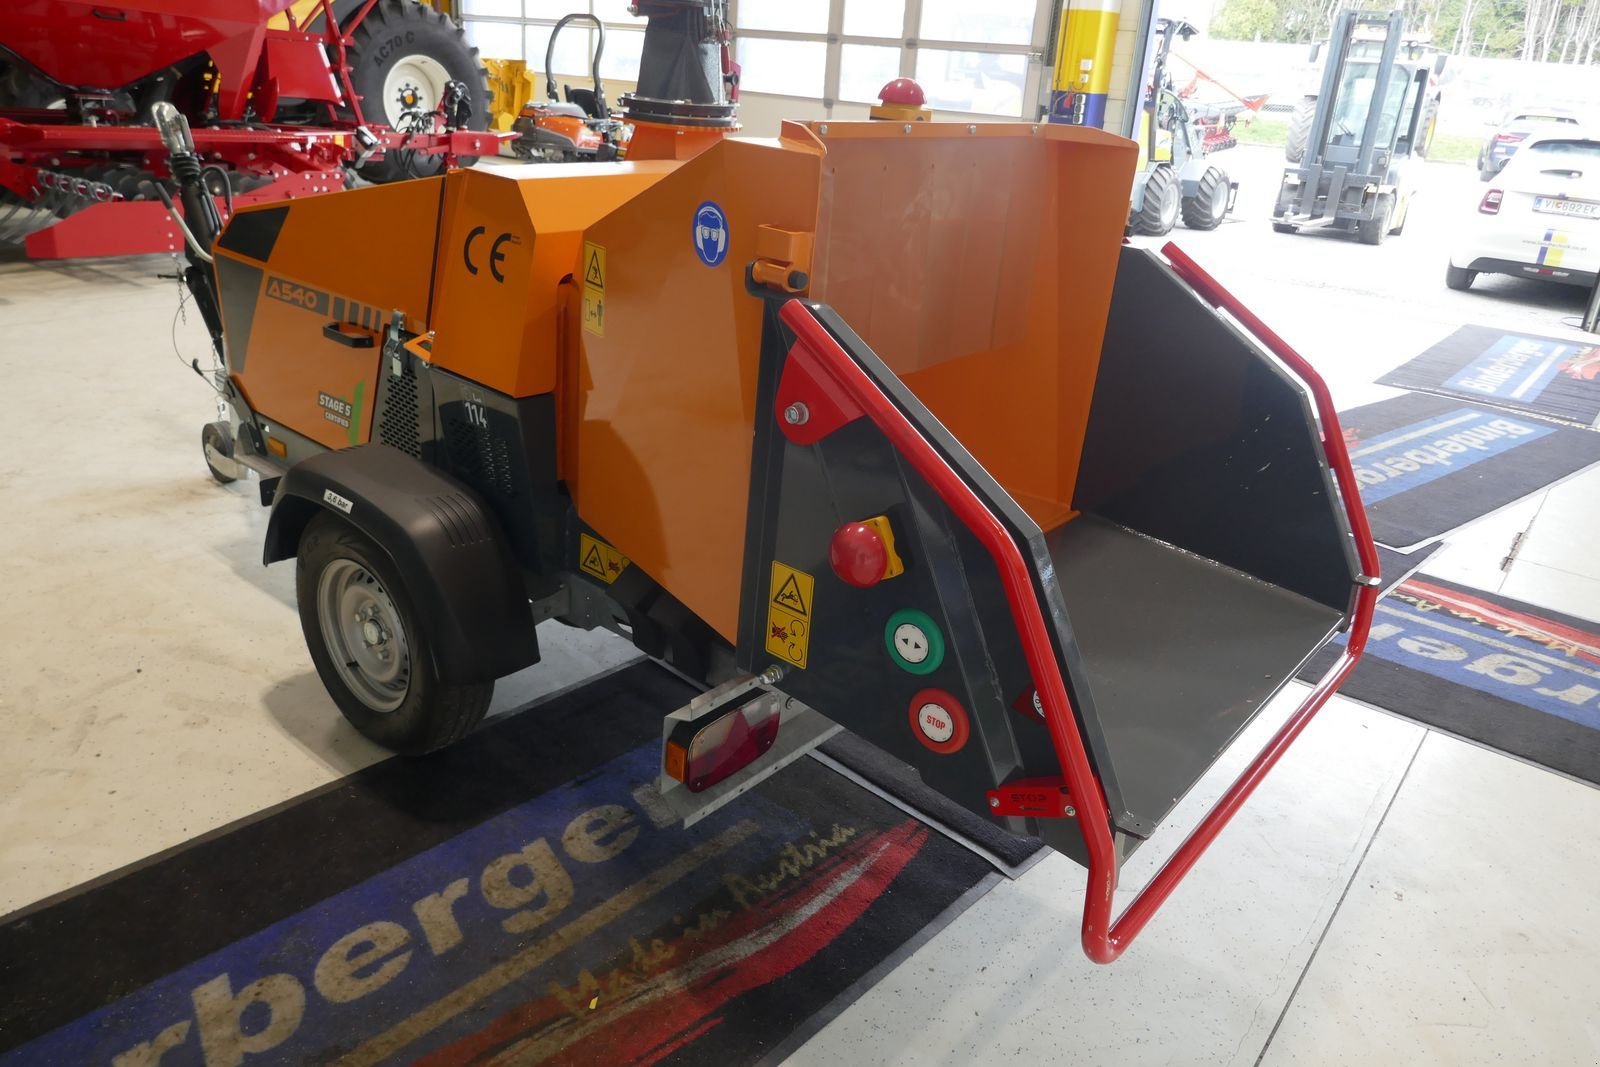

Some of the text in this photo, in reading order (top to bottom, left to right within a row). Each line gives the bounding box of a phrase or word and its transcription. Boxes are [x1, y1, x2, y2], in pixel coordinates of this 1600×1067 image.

[373, 35, 402, 68] AC70
[463, 225, 512, 284] CE
[267, 280, 318, 309] A540
[319, 393, 352, 417] STAGE 5
[464, 401, 488, 428] 114
[1352, 419, 1535, 491] Binderberg
[337, 498, 349, 510] bar
[926, 715, 946, 731] STOP
